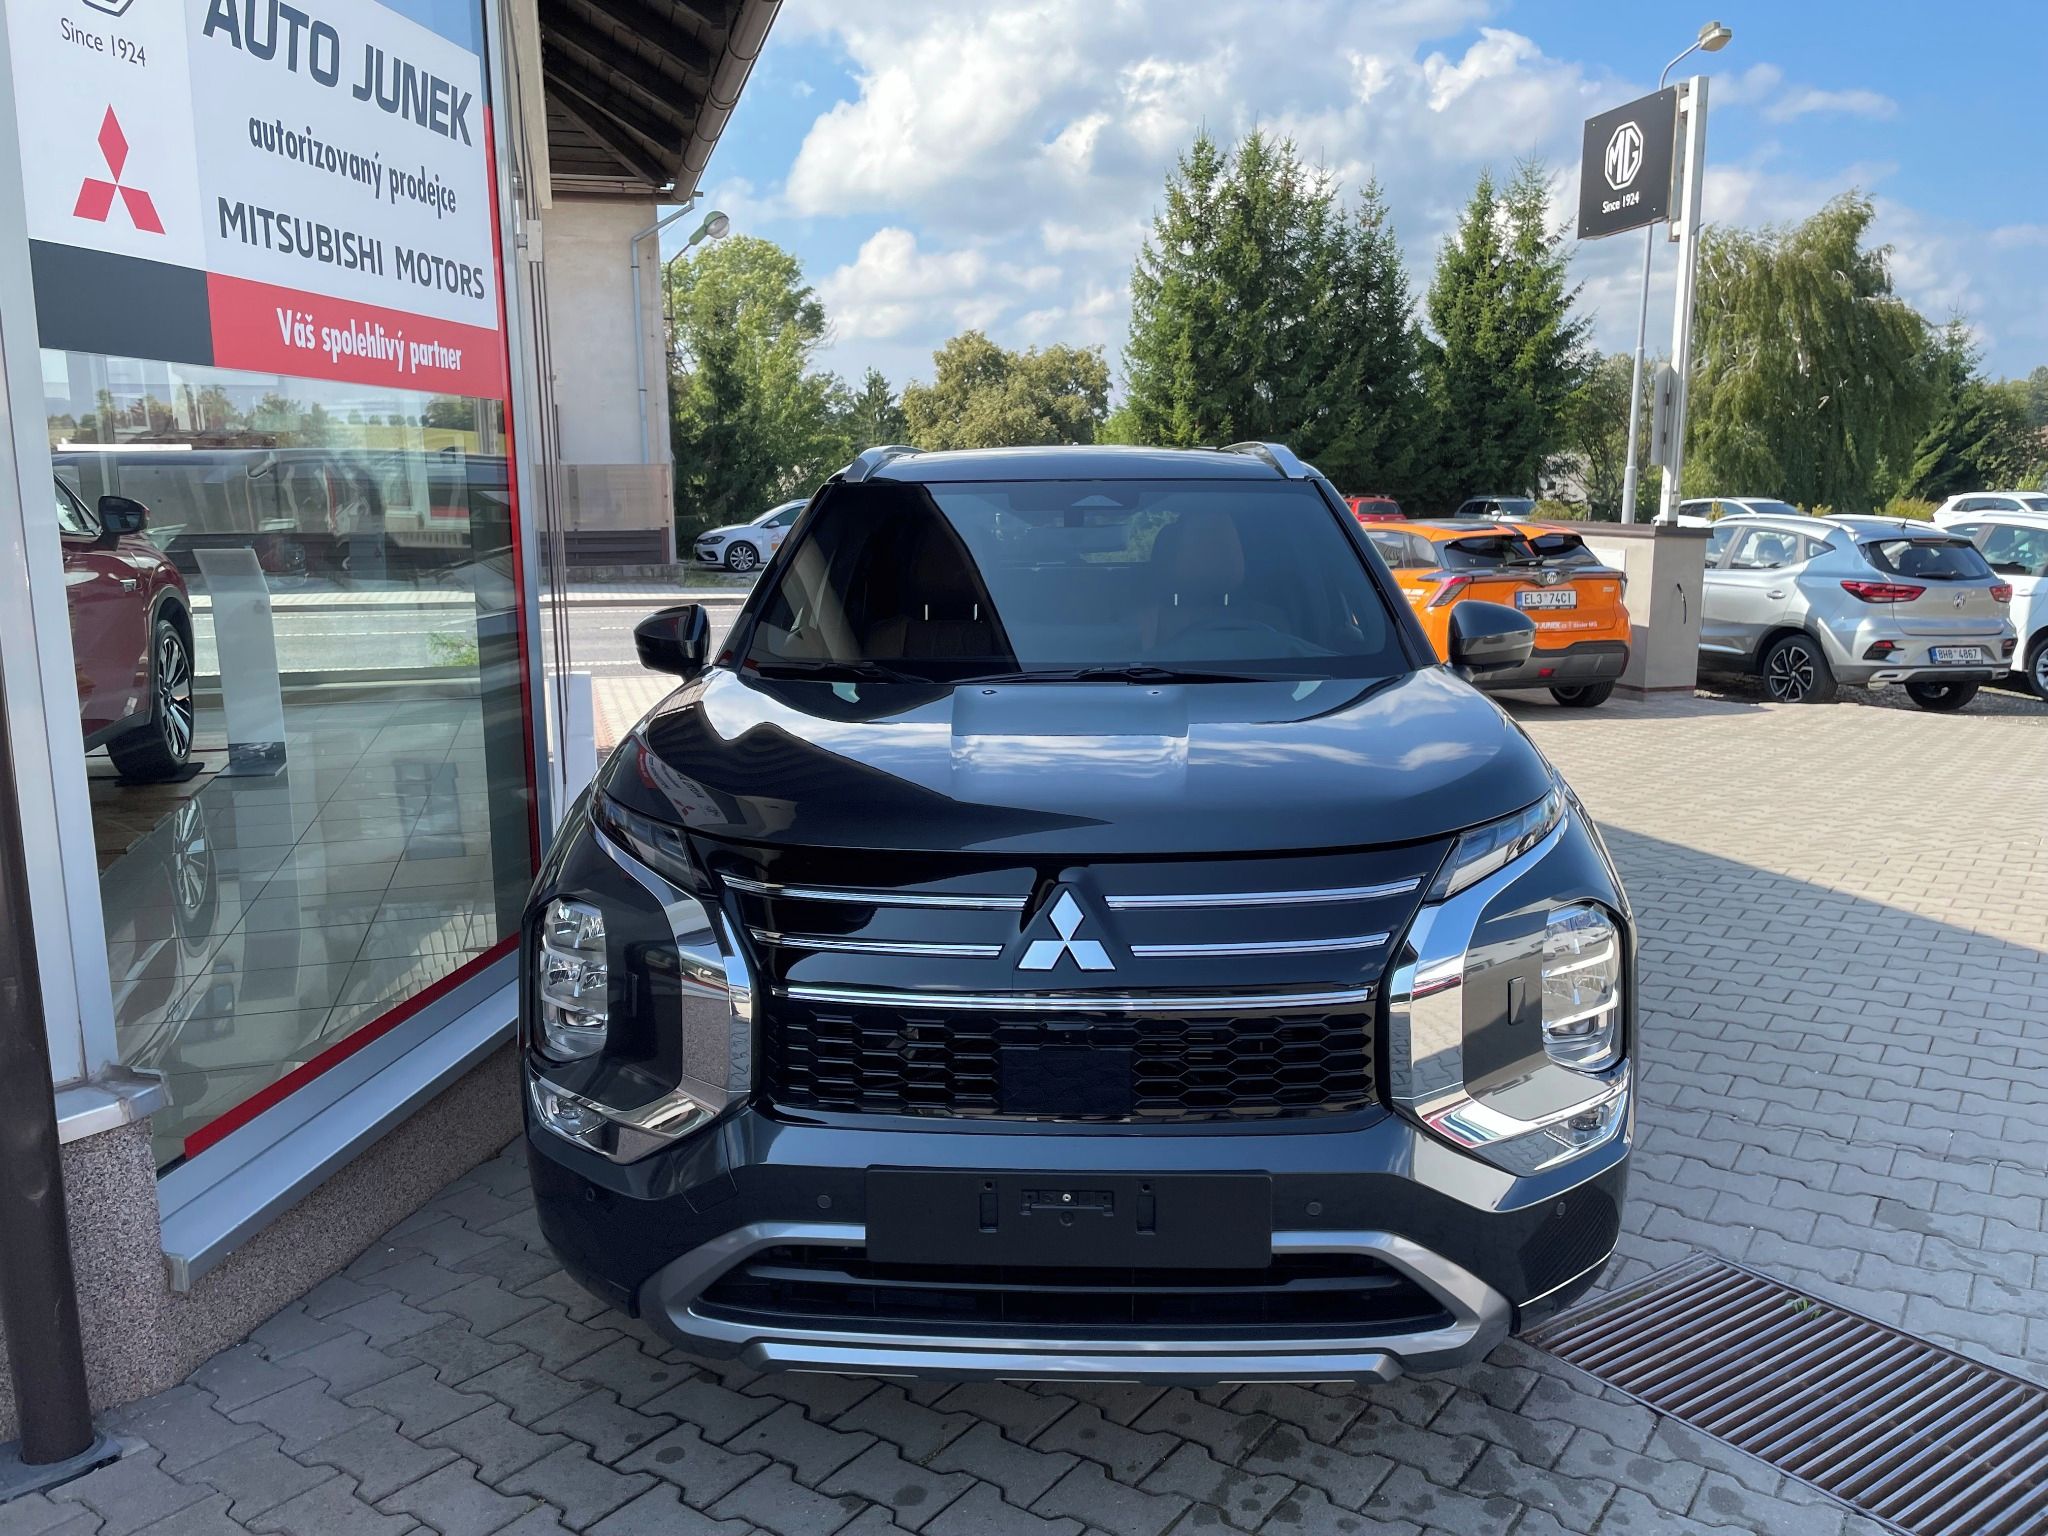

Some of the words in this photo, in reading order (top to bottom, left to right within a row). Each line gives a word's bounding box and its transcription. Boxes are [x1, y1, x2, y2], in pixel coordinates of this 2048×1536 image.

[60, 17, 103, 51] Since
[111, 34, 146, 67] 1924
[203, 0, 340, 88] AUTO
[353, 43, 472, 148] JUNEK
[249, 117, 382, 199] autorizovaný
[389, 165, 456, 219] prodejce
[1606, 125, 1641, 187] MG
[1602, 200, 1620, 214] Since
[1622, 191, 1640, 208] 1924
[218, 196, 384, 276] MITSUBISHI
[395, 246, 485, 299] MOTORS
[276, 307, 316, 349] Váš
[322, 319, 405, 372] spolehlivý
[410, 341, 461, 373] partner
[1524, 594, 1542, 605] EL3
